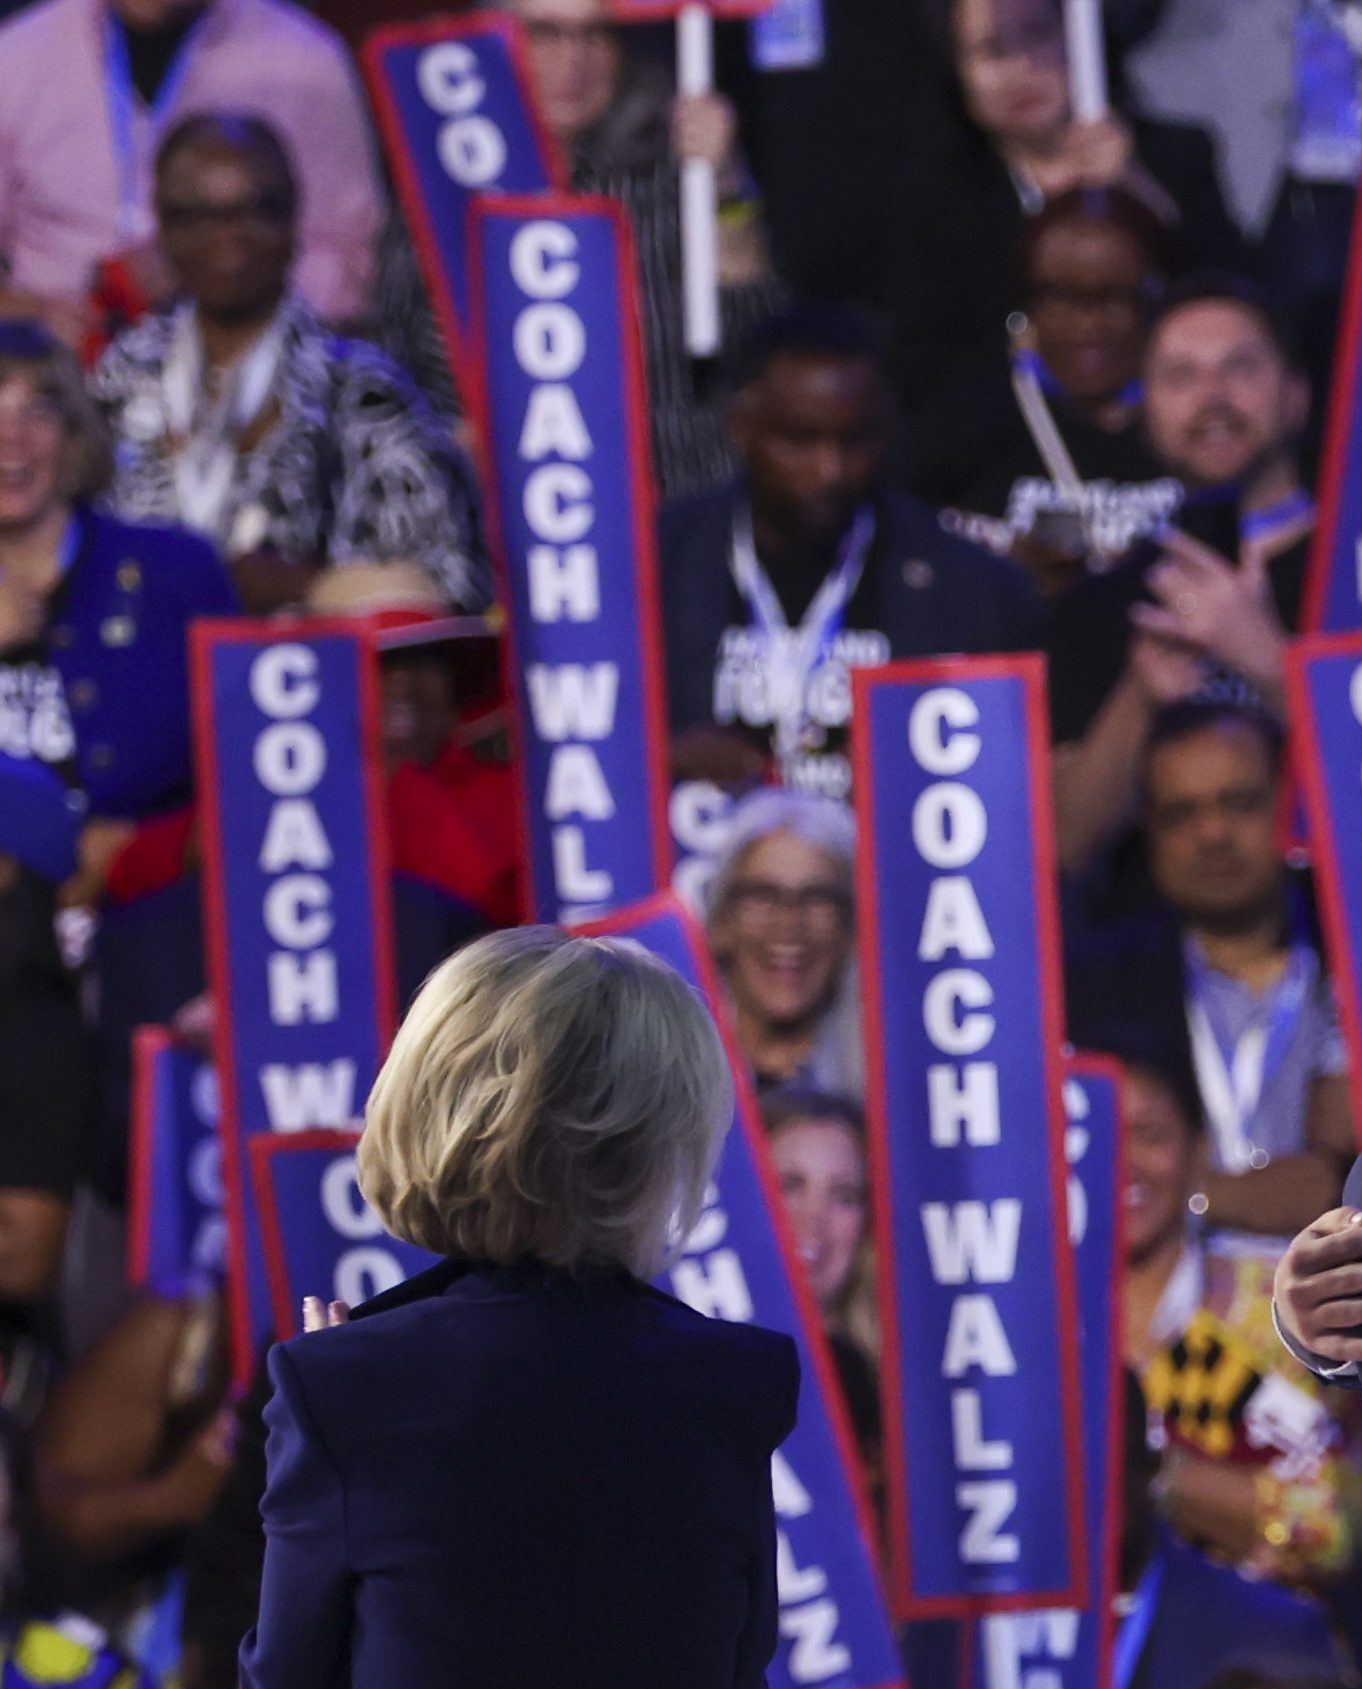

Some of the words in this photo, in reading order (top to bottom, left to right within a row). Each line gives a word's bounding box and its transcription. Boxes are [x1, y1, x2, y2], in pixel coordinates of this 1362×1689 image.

[506, 221, 601, 625] COACH
[249, 643, 342, 1027] COACH
[526, 660, 618, 923] WAL
[906, 686, 996, 1149] COACH
[257, 1055, 364, 1134] W
[920, 1198, 1022, 1565] WALZ
